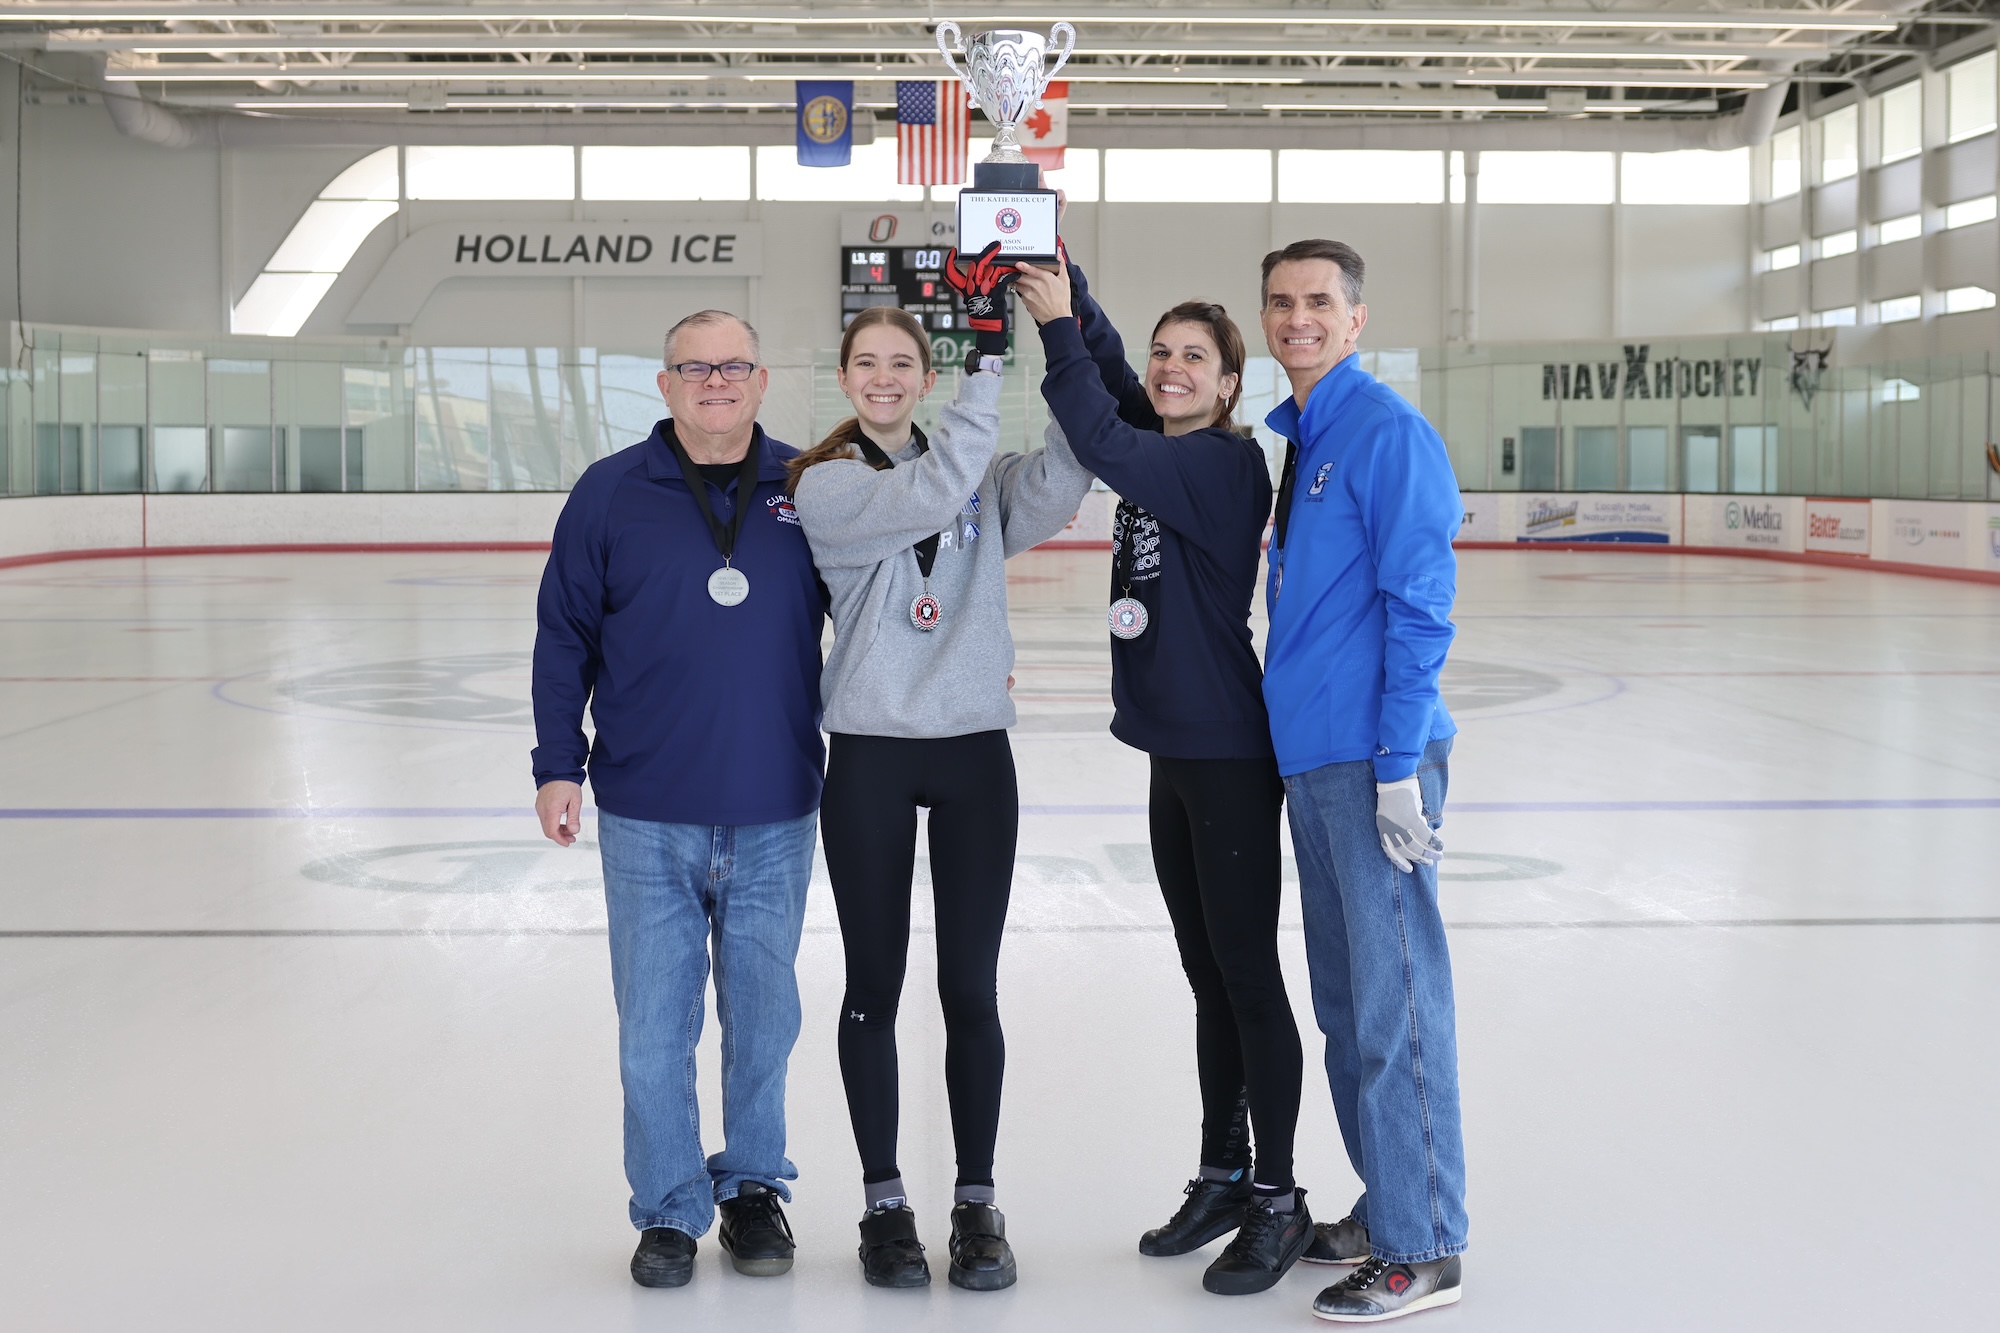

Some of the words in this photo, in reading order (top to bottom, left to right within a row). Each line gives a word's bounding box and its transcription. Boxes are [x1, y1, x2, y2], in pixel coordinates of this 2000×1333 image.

[455, 234, 654, 263] HOLLAND
[671, 234, 737, 263] ICE
[871, 266, 883, 282] 4
[766, 495, 793, 506] CURLI
[1742, 503, 1782, 530] Medica
[1223, 1085, 1247, 1159] ARMOUR
